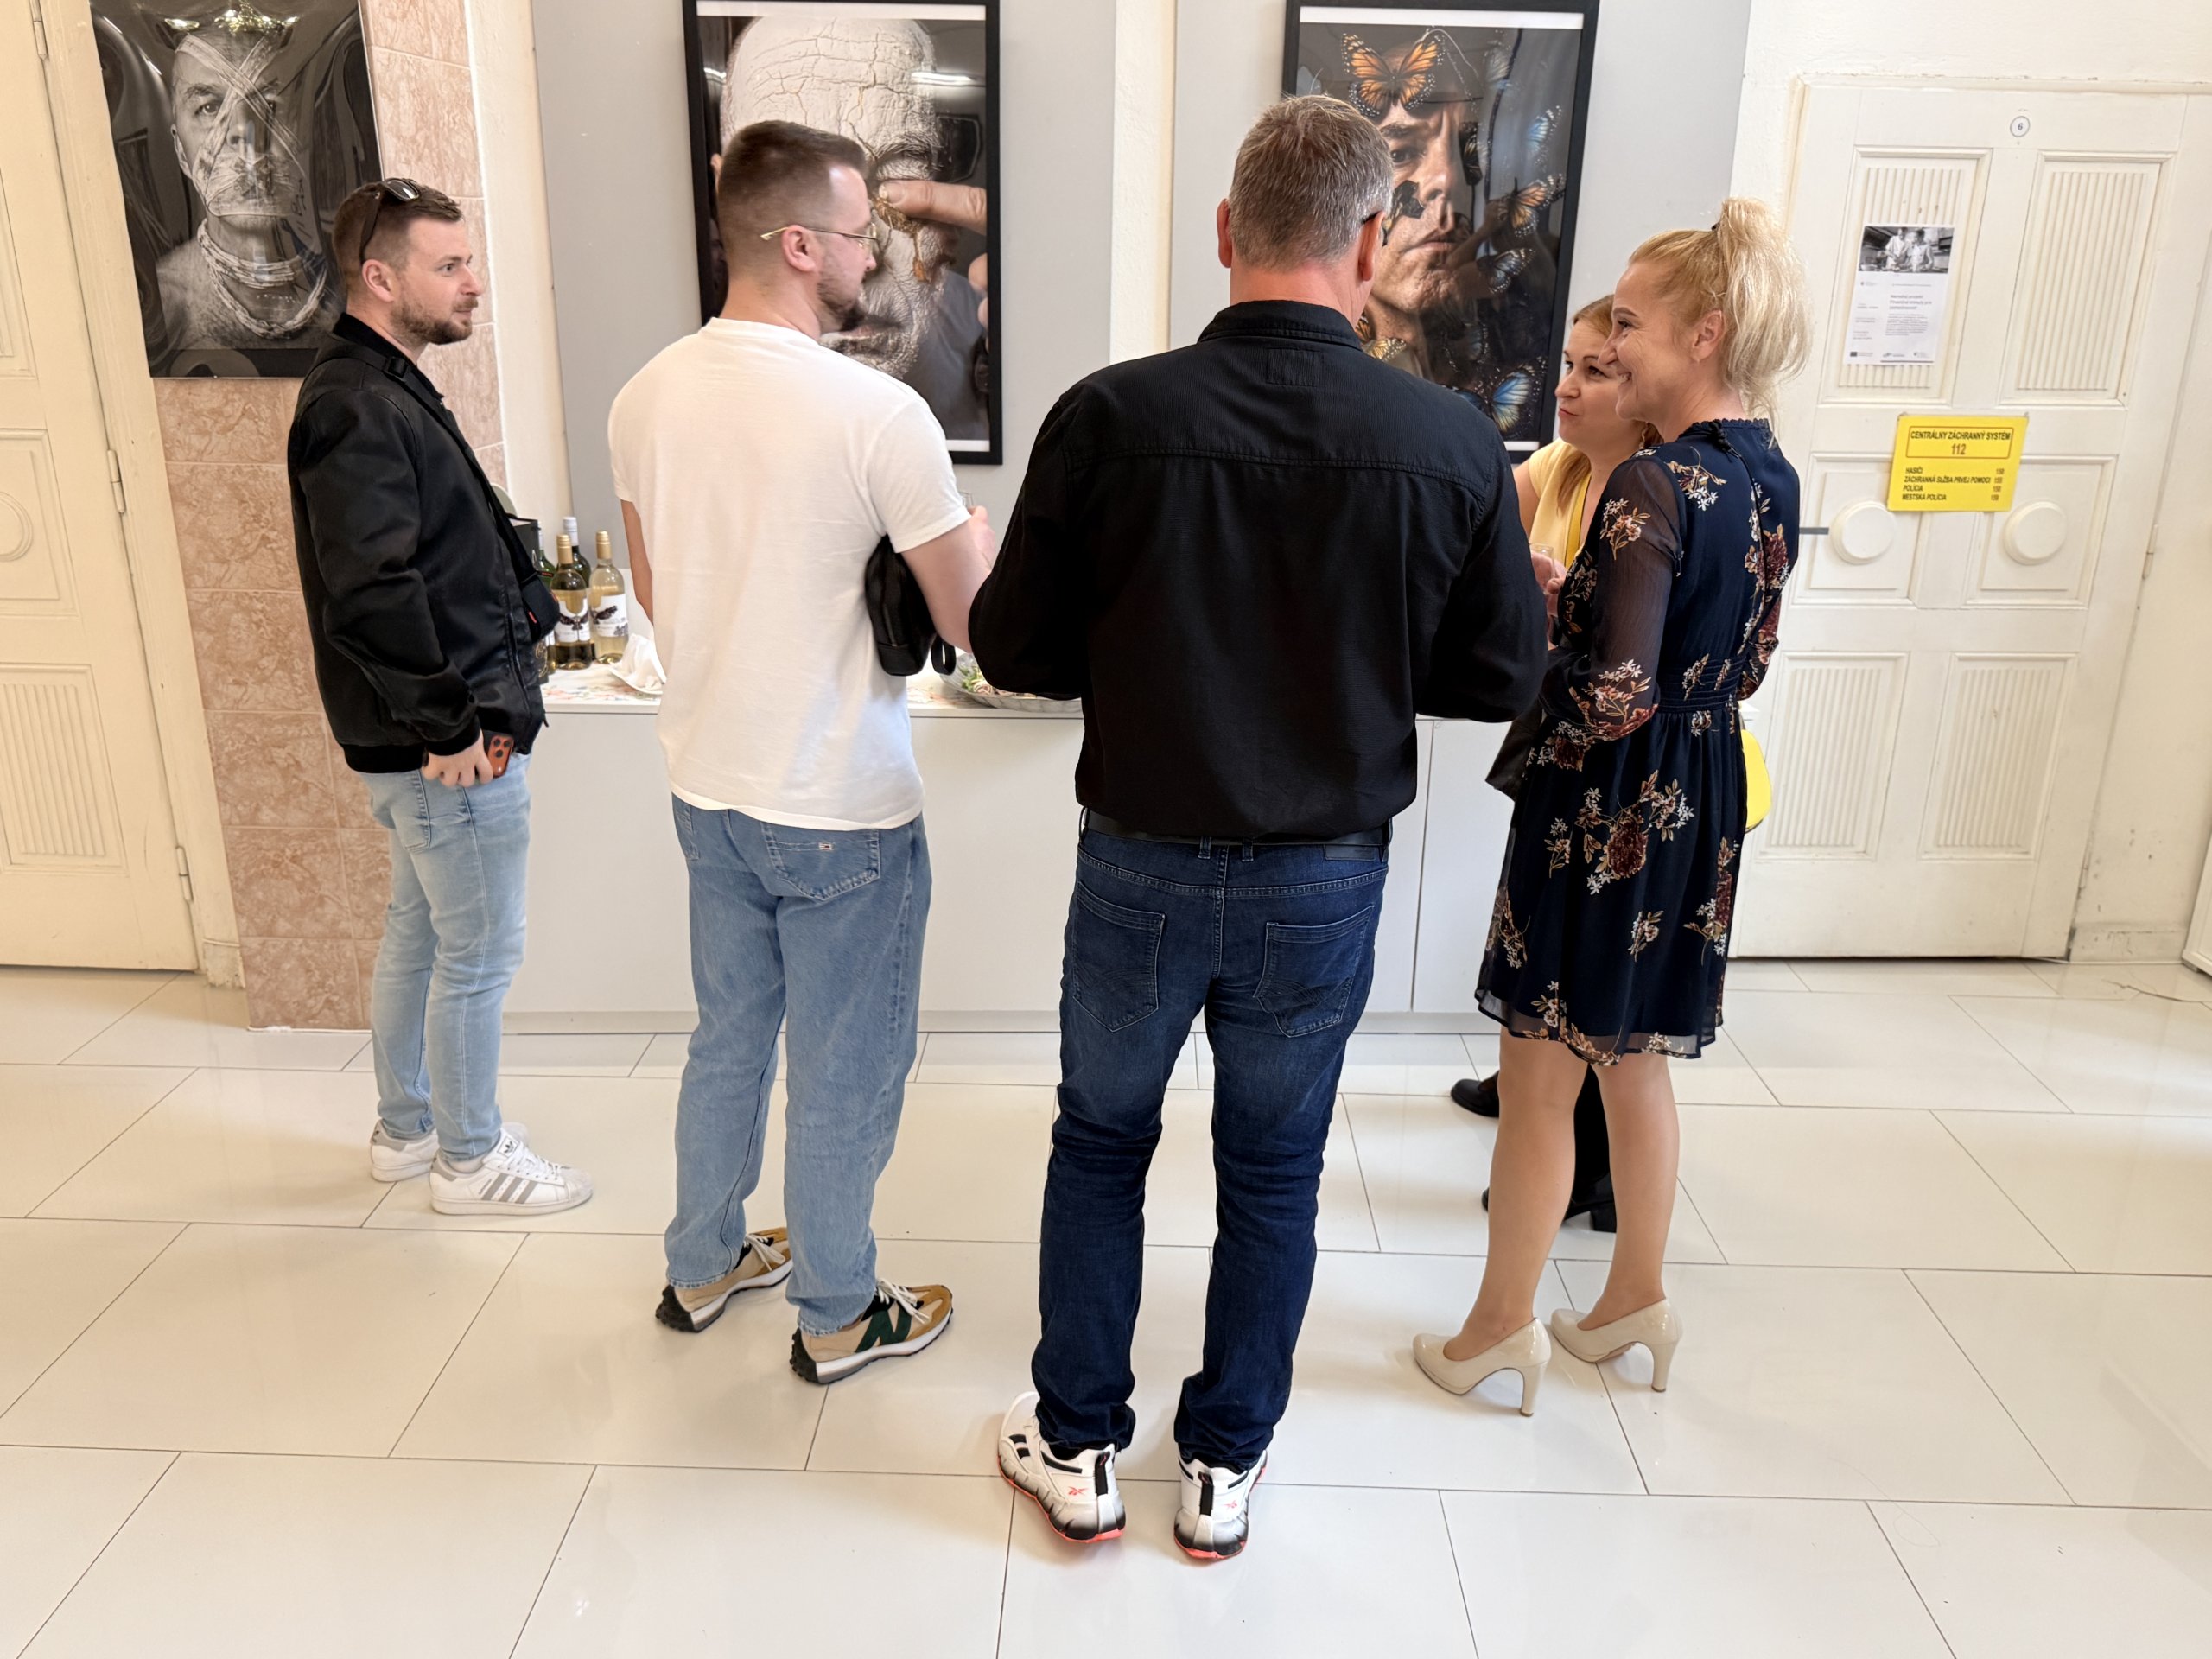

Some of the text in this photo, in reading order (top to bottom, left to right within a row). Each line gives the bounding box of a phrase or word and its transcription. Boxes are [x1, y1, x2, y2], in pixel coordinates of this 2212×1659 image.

[1910, 430, 2011, 440] CENTRÁLNY ZÁCHRANNÝ SYSTÉM
[1951, 443, 1967, 454] 112
